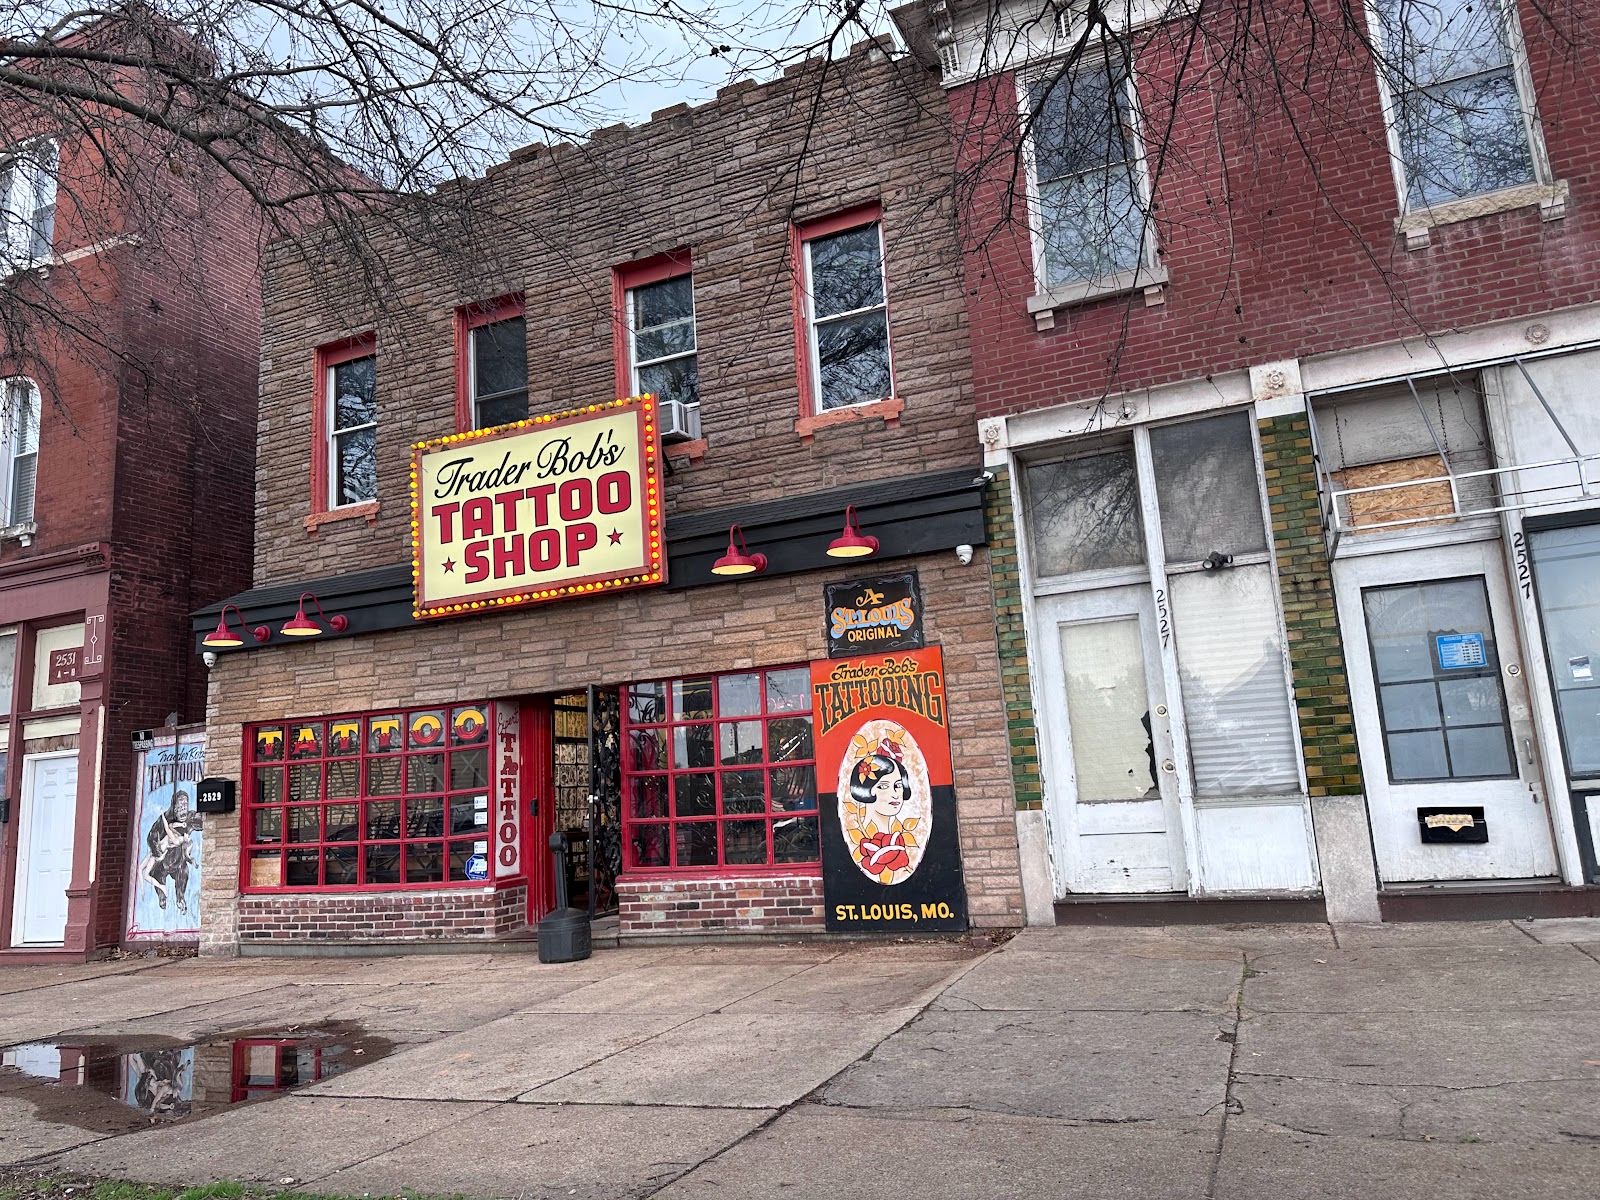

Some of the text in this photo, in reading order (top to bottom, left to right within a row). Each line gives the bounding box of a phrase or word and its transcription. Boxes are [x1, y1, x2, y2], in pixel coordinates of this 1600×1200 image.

[434, 428, 626, 499] Trader Bob's
[431, 470, 632, 545] TATTOO
[464, 522, 598, 584] SHOP
[1513, 532, 1530, 600] 2527
[856, 588, 885, 607] A
[1156, 589, 1170, 650] 2527
[55, 652, 76, 667] 2531
[848, 625, 902, 643] ORIGINAL
[831, 657, 918, 681] Trader Bob's
[814, 671, 946, 737] TATTOOING
[258, 709, 487, 757] TATTOO
[203, 792, 222, 802] 2529
[500, 733, 519, 867] TATTOO
[835, 902, 955, 923] ST. LOUIS, MO.
